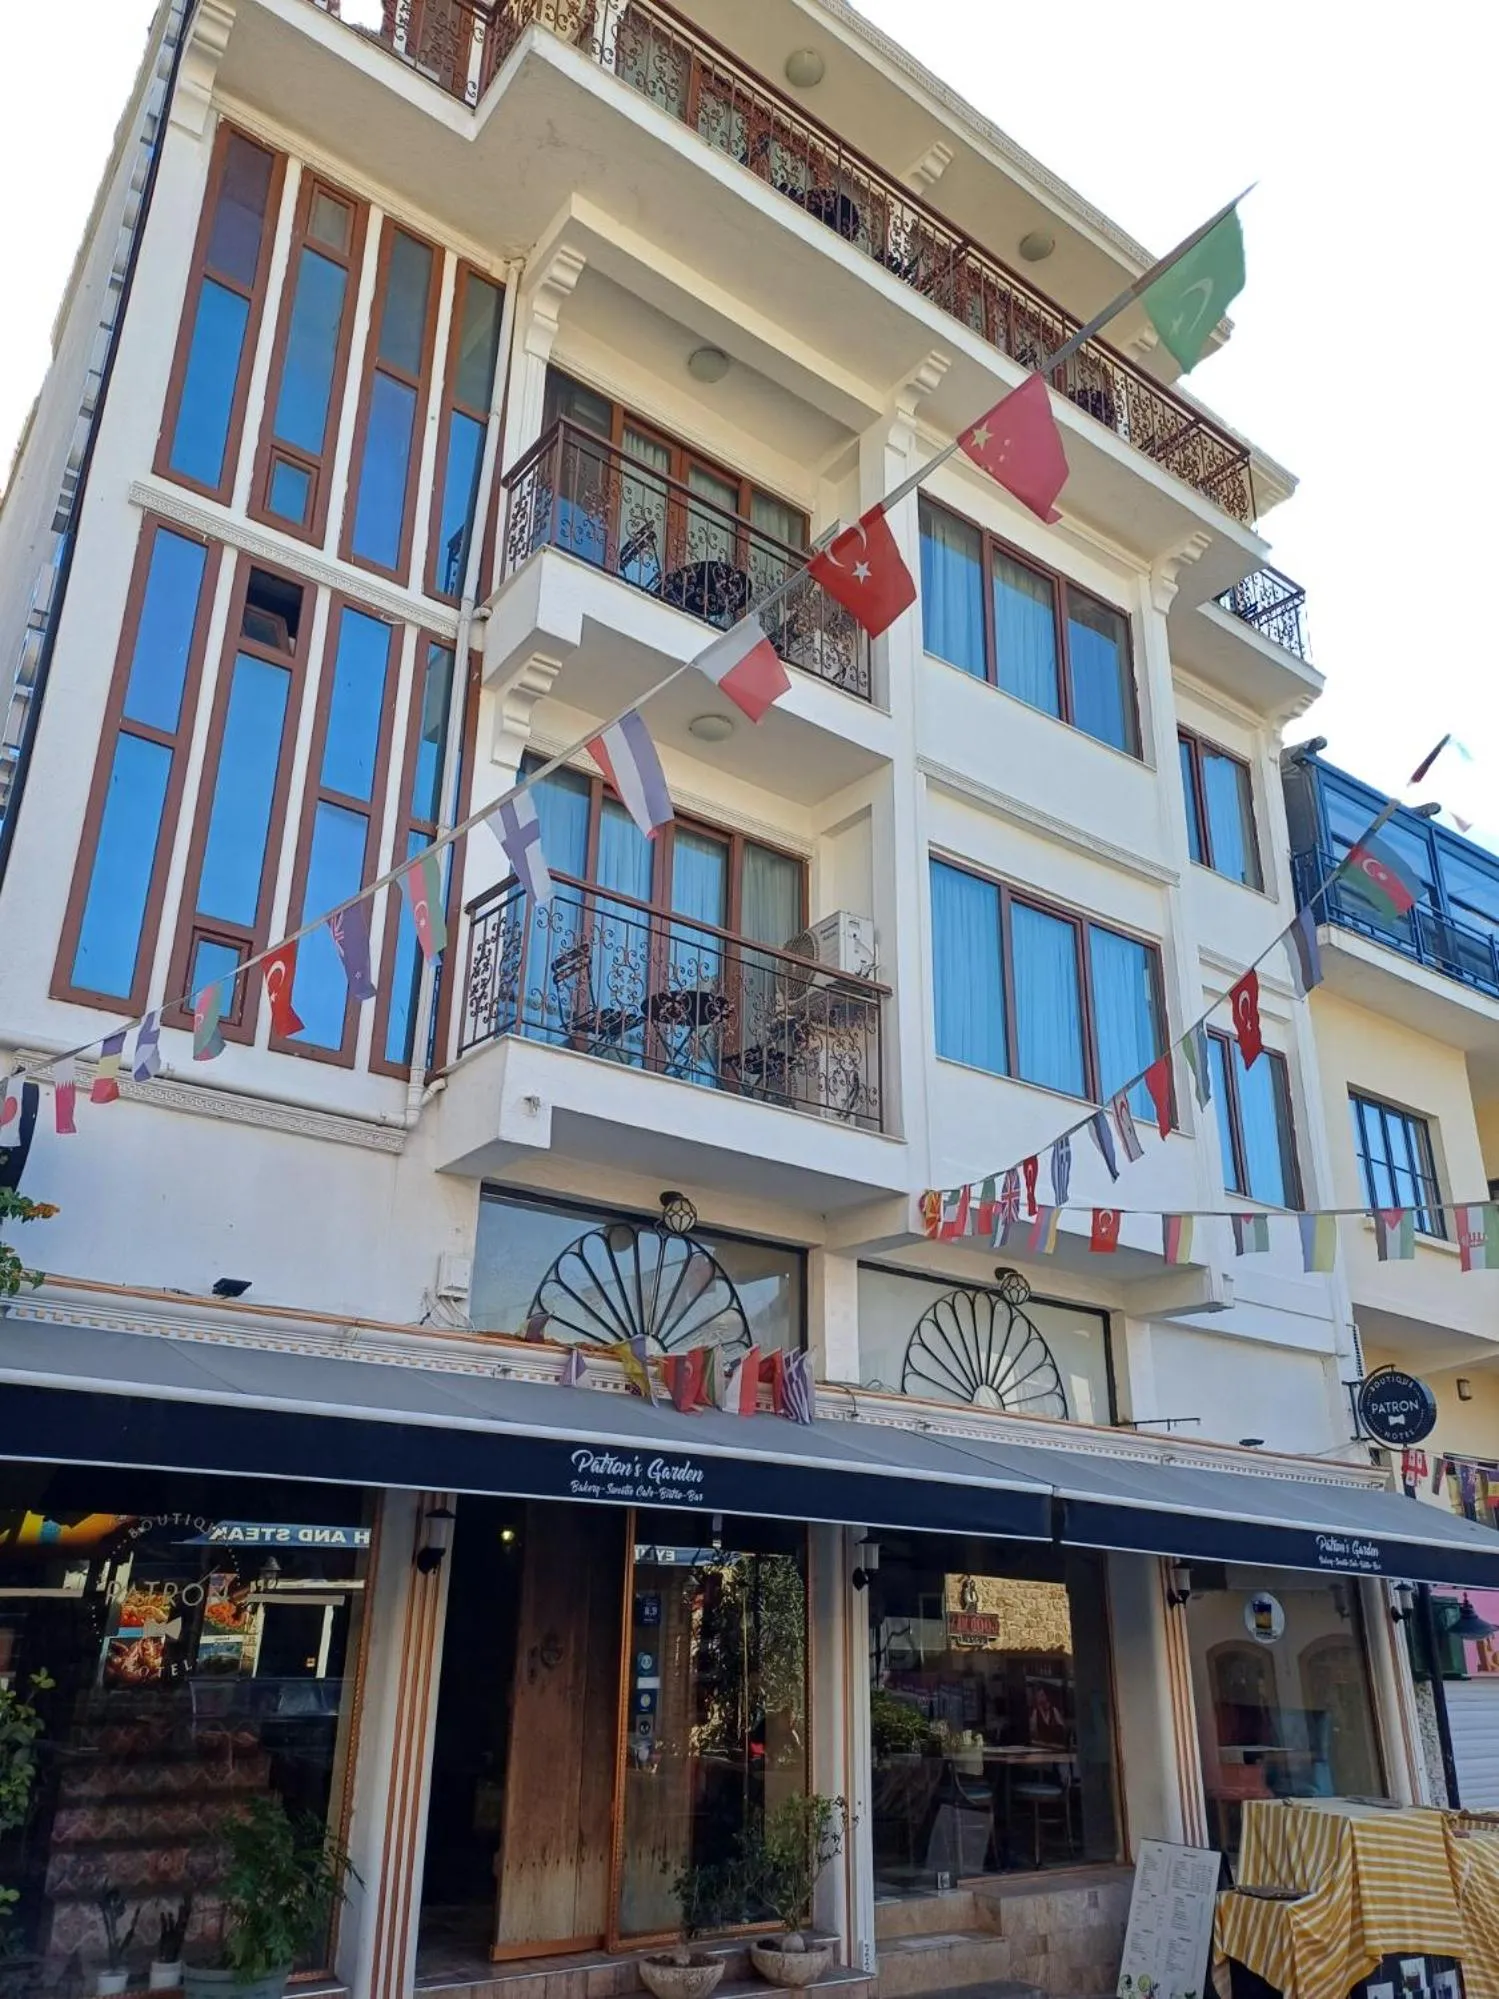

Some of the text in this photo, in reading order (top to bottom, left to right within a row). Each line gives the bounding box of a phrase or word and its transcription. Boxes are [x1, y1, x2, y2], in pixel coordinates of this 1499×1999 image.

[1369, 1375, 1415, 1392] BOUTIQUE
[1371, 1400, 1420, 1415] PATRON
[1384, 1428, 1415, 1440] HOTEL
[570, 1449, 704, 1485] Patron's Garden
[128, 1513, 223, 1542] BOUTIQ
